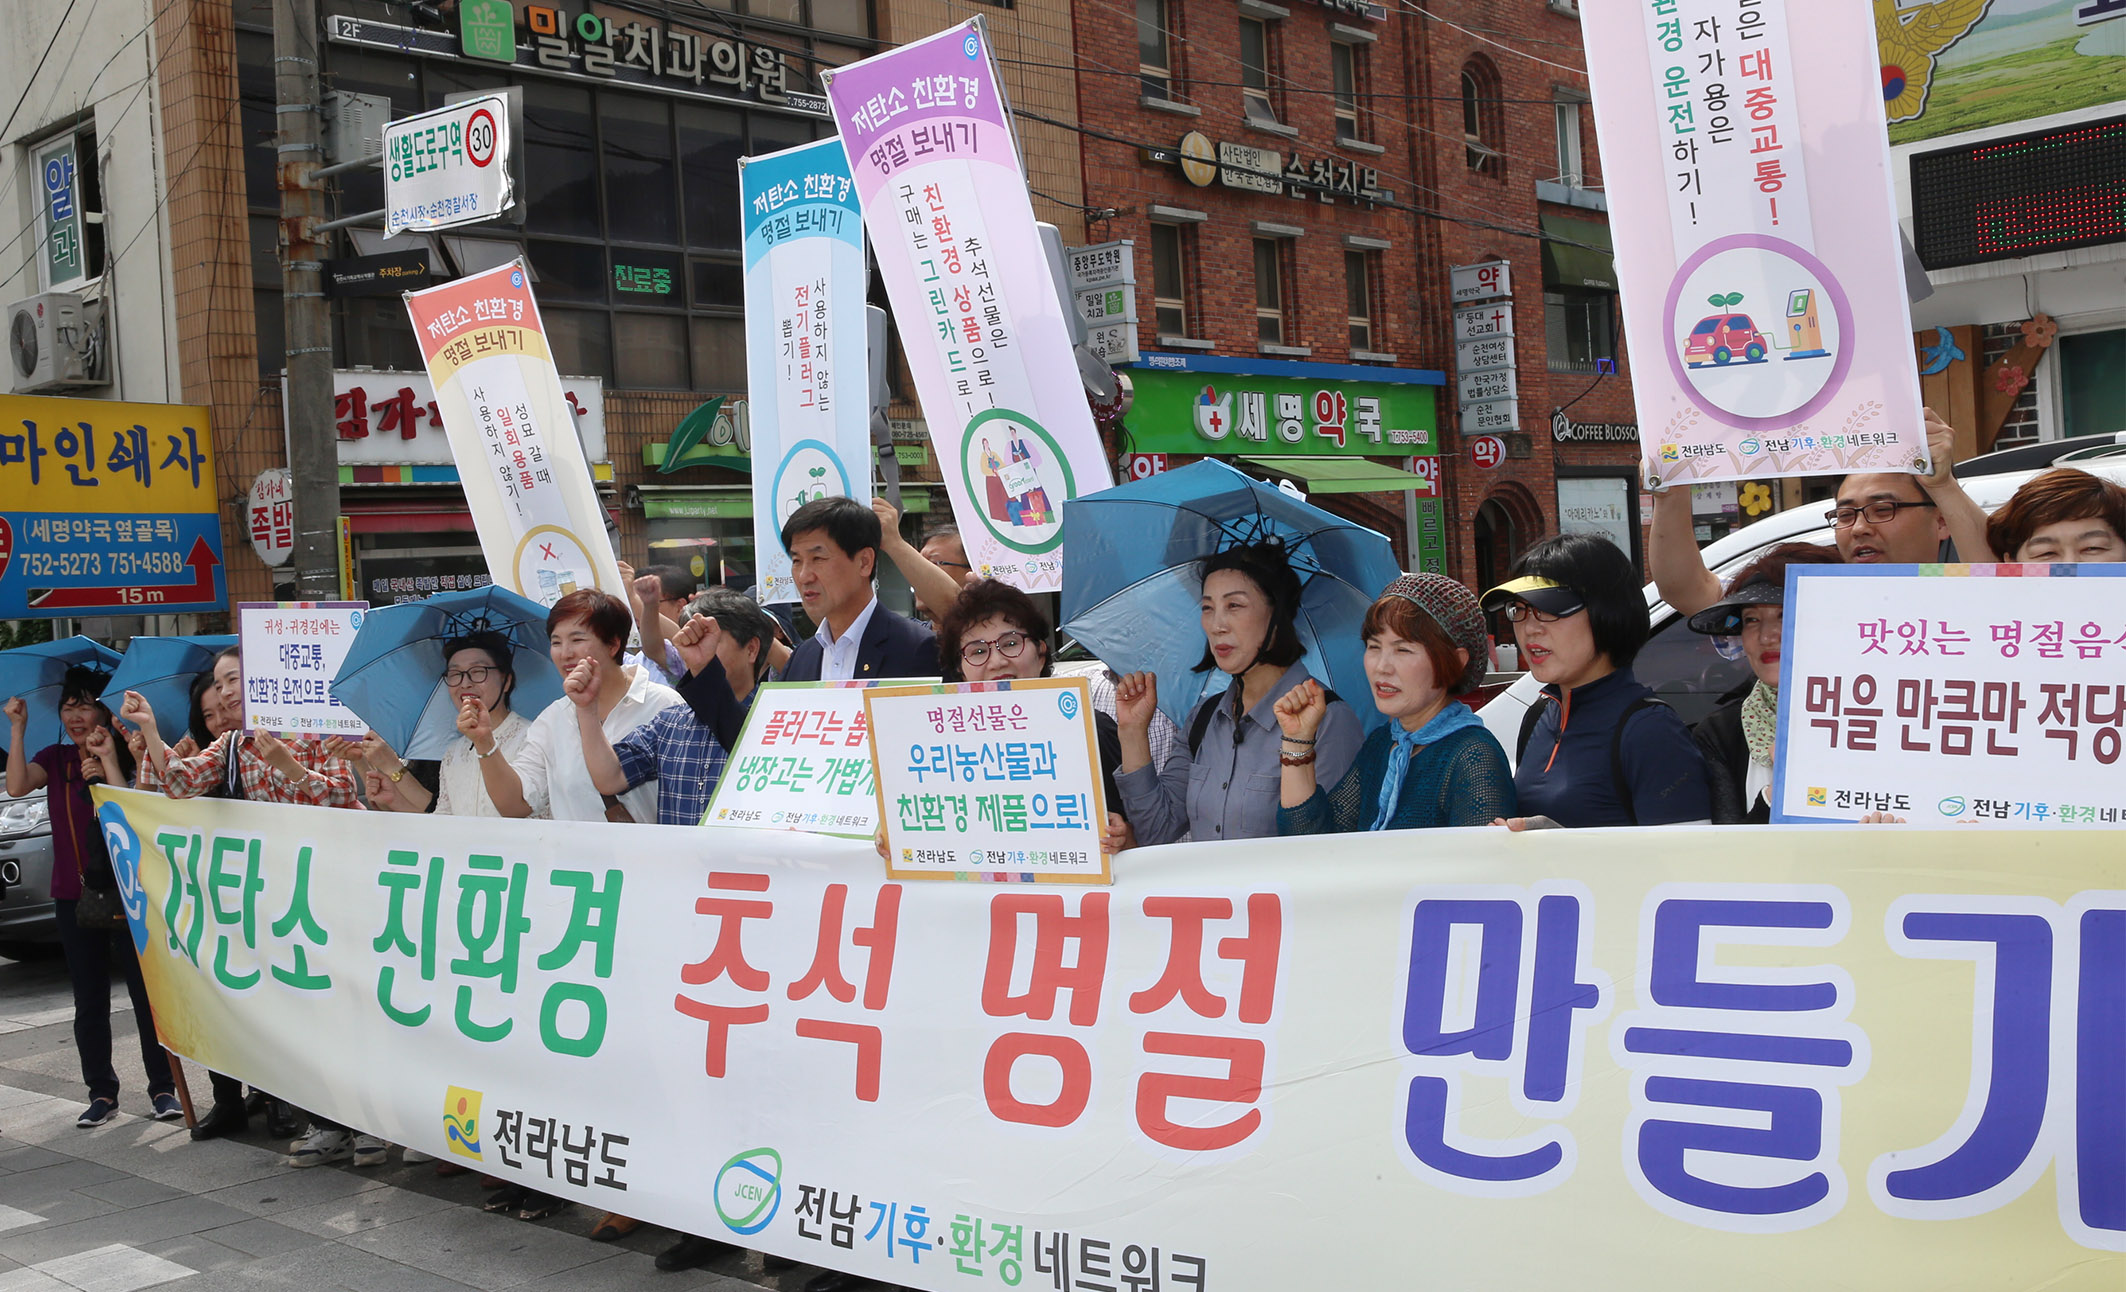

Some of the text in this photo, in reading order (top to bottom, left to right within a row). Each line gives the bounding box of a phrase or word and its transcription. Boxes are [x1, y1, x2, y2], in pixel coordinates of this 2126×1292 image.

[341, 22, 361, 38] 2F
[528, 8, 787, 101] 밀알치과의원
[1693, 15, 1734, 144] 자가용은
[850, 74, 979, 135] 저탄소 친환경
[389, 121, 463, 182] 생활도로구역
[472, 124, 491, 152] 30
[869, 122, 978, 175] 명절 보내기
[1662, 65, 1701, 225] 운전하기!
[1739, 47, 1787, 226] 대중교통!
[1223, 145, 1261, 167] 사단법인
[753, 172, 852, 215] 저탄소 친환경
[1285, 152, 1384, 210] 순천지부
[761, 207, 843, 246] 명절 보내기
[899, 184, 928, 250] 구매는
[1074, 249, 1120, 272] 중앙무도학원
[614, 264, 671, 294] 진료중
[922, 182, 996, 409] 친환경 상품으로!
[1456, 286, 1481, 296] 세명약국
[1478, 267, 1500, 292] 약
[427, 296, 524, 340] 저탄소 친환경
[1085, 293, 1103, 307] 밀알
[1086, 308, 1104, 319] 치과
[1466, 312, 1484, 324] 등대
[443, 329, 524, 366] 명절 보내기
[794, 284, 815, 407] 전기플러그
[813, 277, 831, 412] 사용하지 않는
[1467, 323, 1494, 337] 선교회
[1472, 341, 1505, 355] 순천여성
[782, 318, 795, 381] 뽑기!
[1473, 353, 1507, 366] 상담센터
[1467, 385, 1509, 398] 법률상담소
[1474, 372, 1507, 386] 한국가정
[334, 386, 442, 440] 김가
[473, 386, 506, 458] 사용하지
[1237, 389, 1382, 448] 세명약국
[1476, 404, 1493, 415] 순천
[1477, 413, 1510, 427] 문인협회
[496, 406, 535, 490] 일회용품
[514, 403, 552, 485] 성묘 갈 때
[1571, 423, 1639, 441] COFFEE BLOSSO
[1681, 442, 1727, 458] 전라남도
[1474, 441, 1496, 464] 약
[256, 477, 285, 500] 김가네
[251, 501, 292, 550] 족발
[1421, 500, 1440, 551] 빠르고
[19, 551, 183, 576] 752-5273 751-4588
[264, 619, 341, 635] 귀성·귀경길에는
[1856, 618, 1971, 657] 맛있는
[279, 643, 326, 672] 대중교통,
[248, 676, 279, 705] 친환경
[281, 677, 325, 705] 운전으로
[260, 716, 283, 727] 전라남도
[760, 710, 844, 746] 플러그는
[926, 703, 1029, 734] 명절선물은
[1805, 673, 1884, 752] 먹을
[1896, 678, 2027, 757] 만큼만
[736, 756, 814, 793] 냉장고는
[907, 740, 1058, 784] 우리농산물과
[728, 809, 762, 821] 전라남도
[897, 792, 1090, 833] 친환경 제품으로!
[1833, 789, 1911, 812] 전라남도
[916, 850, 957, 864] 전라남도
[156, 833, 2126, 1232] 저탄소 친환경 추석 명절 만들기
[493, 1109, 631, 1191] 전라남도
[734, 1182, 763, 1202] JCEN
